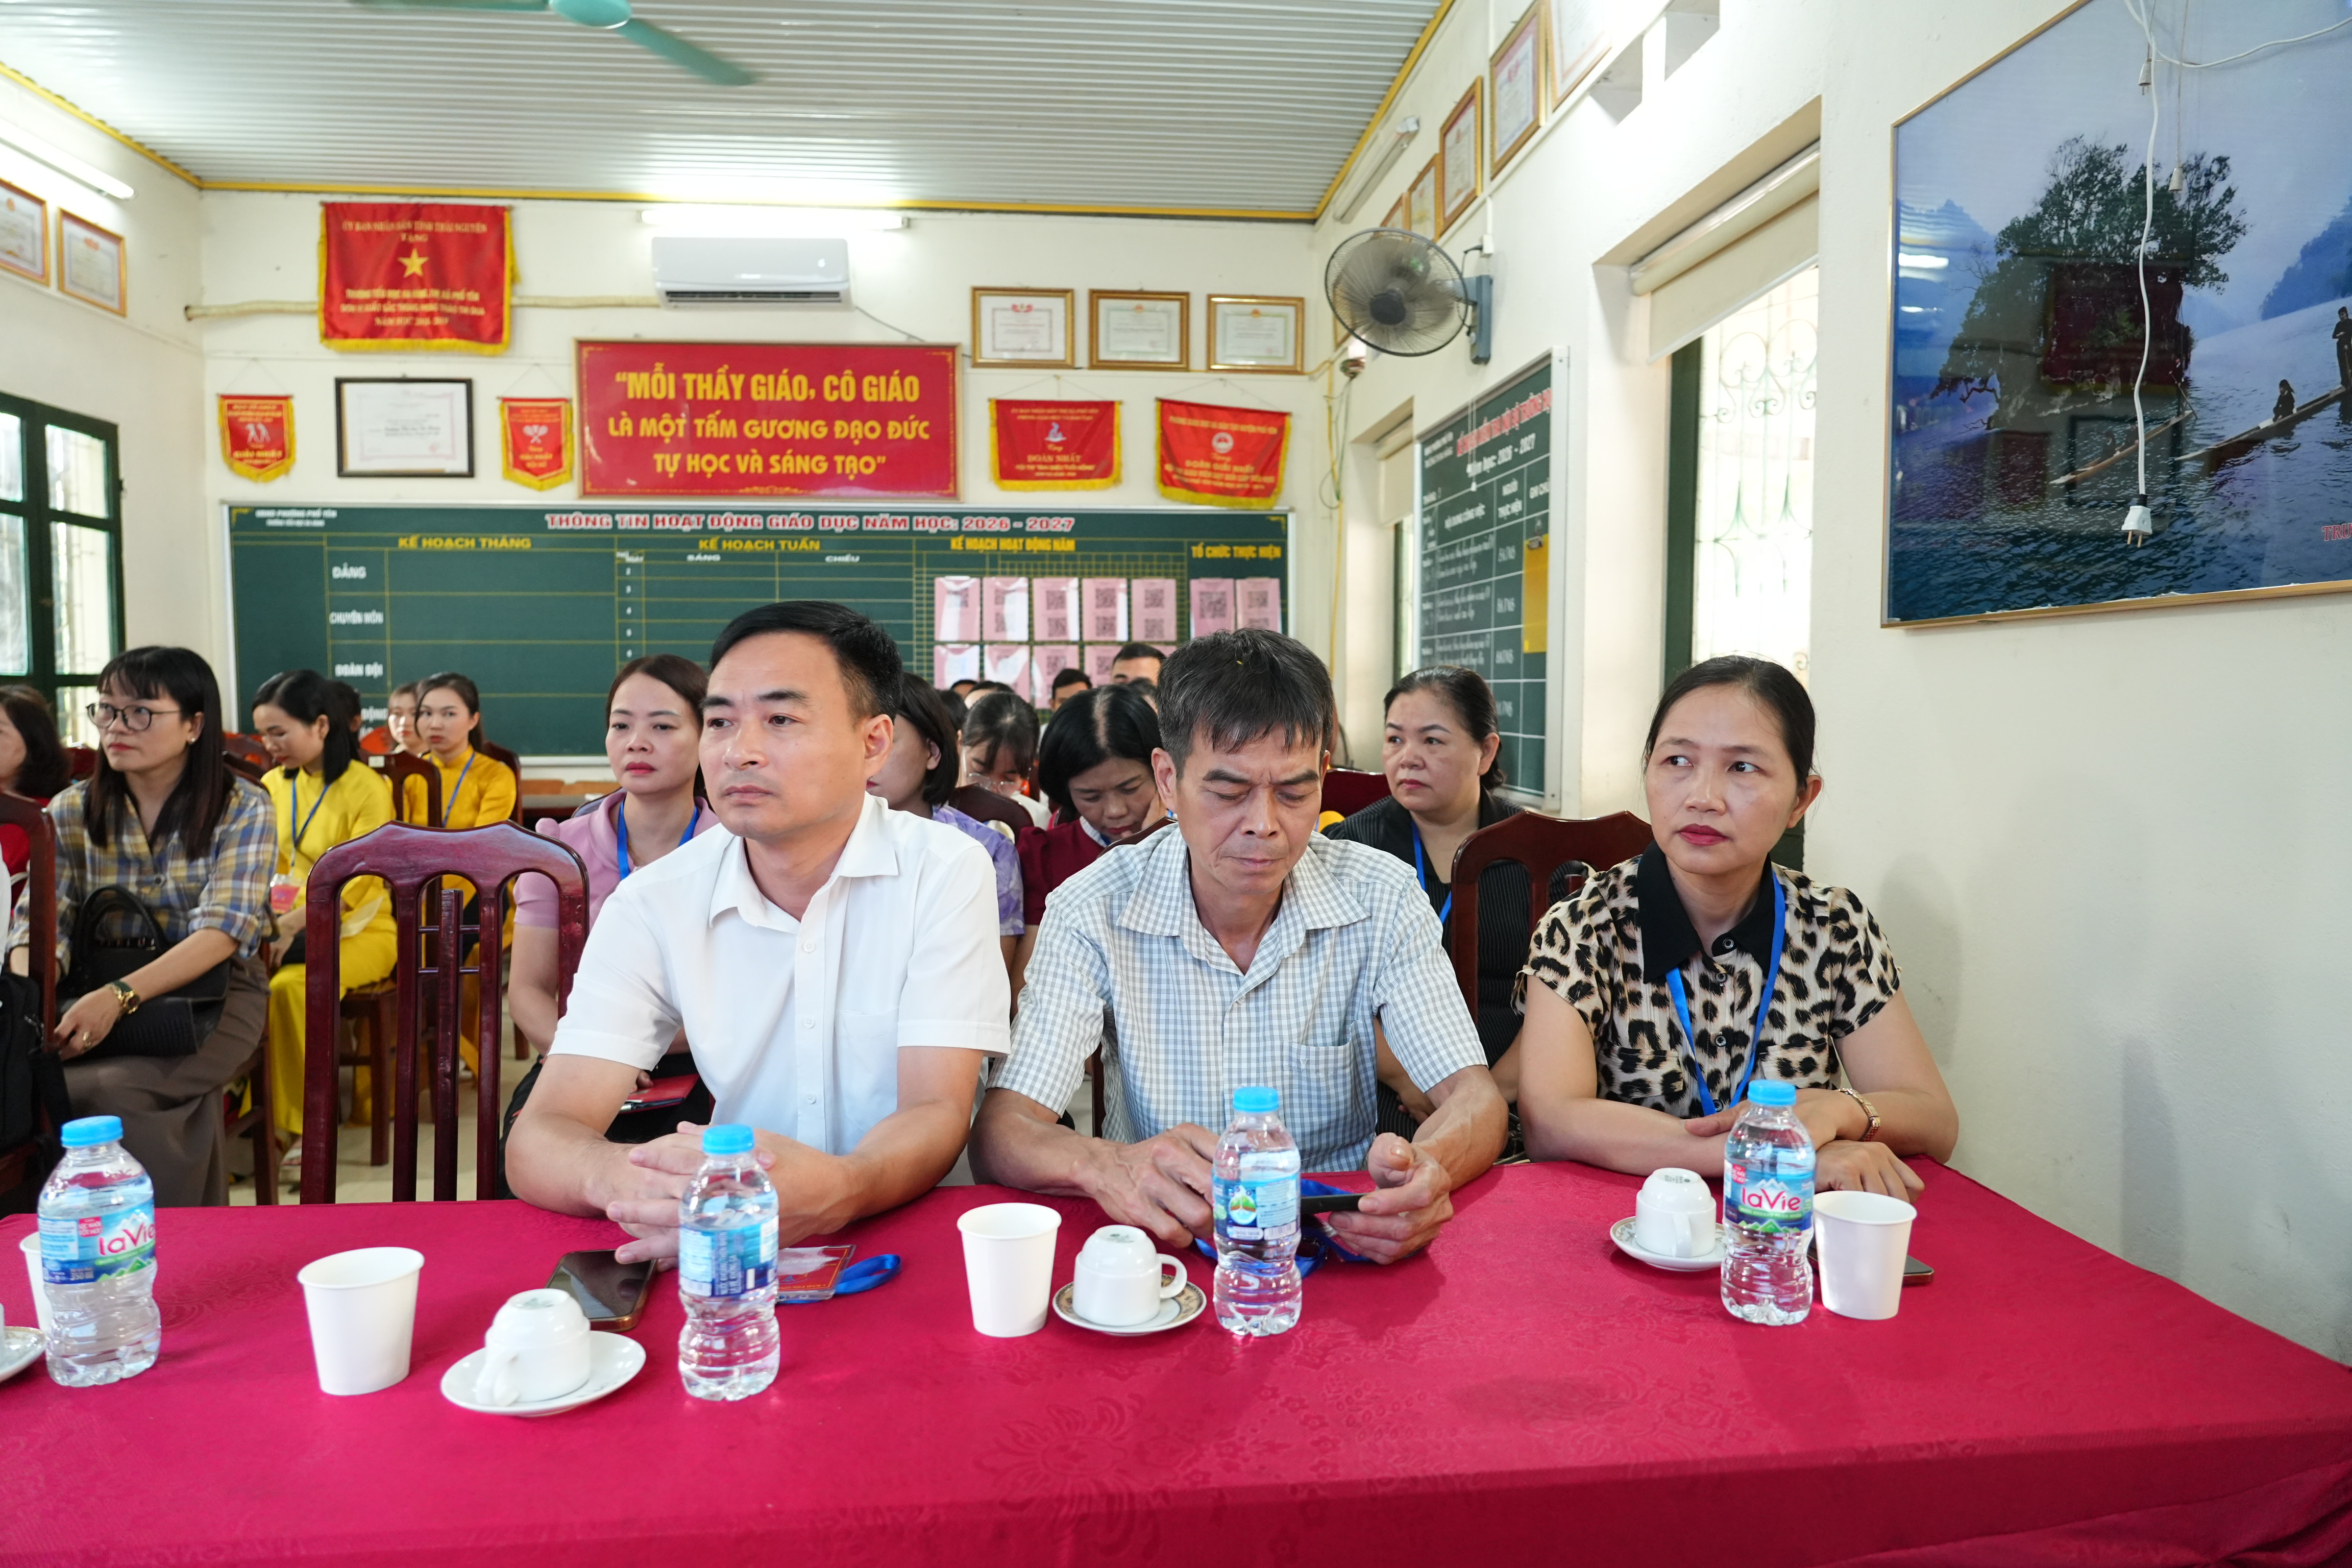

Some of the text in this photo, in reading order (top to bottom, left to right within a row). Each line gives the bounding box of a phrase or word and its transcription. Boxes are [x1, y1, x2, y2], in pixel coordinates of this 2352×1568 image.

[751, 368, 816, 401] GIÁO,
[823, 369, 856, 402] CÔ
[862, 370, 920, 402] GIÁO
[608, 409, 930, 446] LÀ MỘT TẤM GƯƠNG ĐẠO ĐỨC
[653, 453, 682, 479] TỰ
[687, 453, 730, 479] HỌC
[736, 448, 764, 474] VÀ
[769, 449, 829, 475] SÁNG
[545, 511, 612, 530] THÔNG
[615, 513, 650, 530] TIN
[653, 513, 705, 532] HOẠT
[708, 512, 764, 532] ĐỘNG
[767, 512, 814, 530] GIÁO
[818, 514, 860, 533] DỤC
[863, 513, 910, 531] NĂM
[913, 516, 959, 533] HỌC:
[962, 517, 1011, 532] 2026
[1025, 517, 1075, 532] 2027
[398, 534, 532, 550] KẾ HOẠCH THÁNG
[699, 536, 720, 550] KẾ
[722, 539, 775, 552] HOẠCH
[1742, 1186, 1802, 1211] laVie
